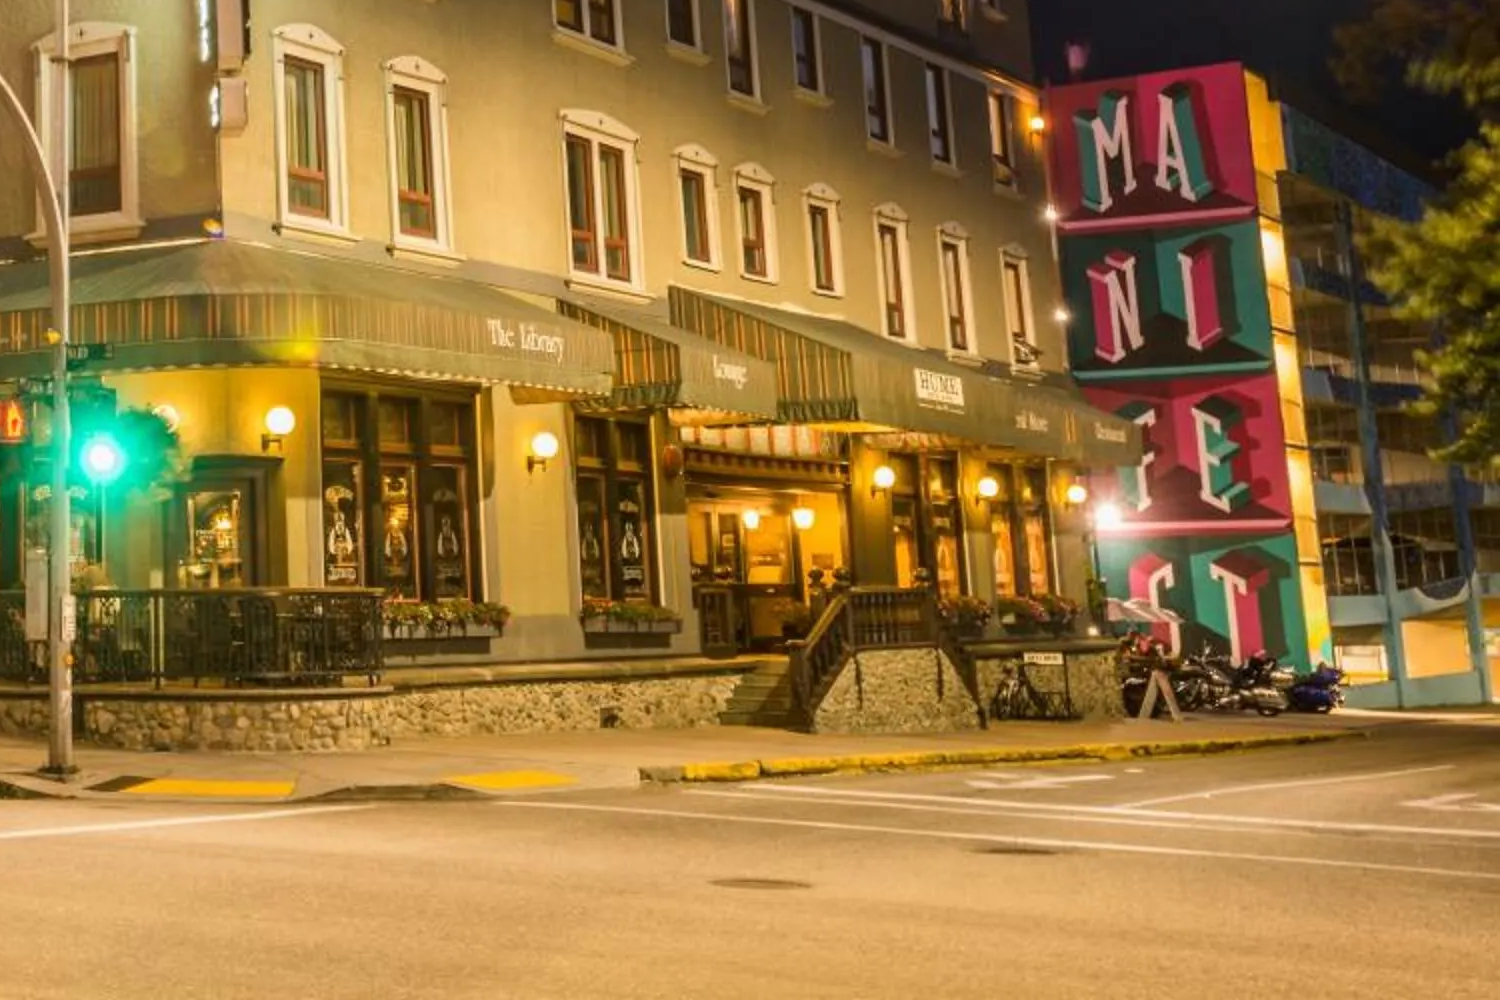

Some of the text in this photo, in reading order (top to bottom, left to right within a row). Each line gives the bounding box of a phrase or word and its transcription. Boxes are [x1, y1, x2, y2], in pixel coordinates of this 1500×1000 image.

[486, 318, 565, 369] The Library
[918, 370, 960, 397] HUME
